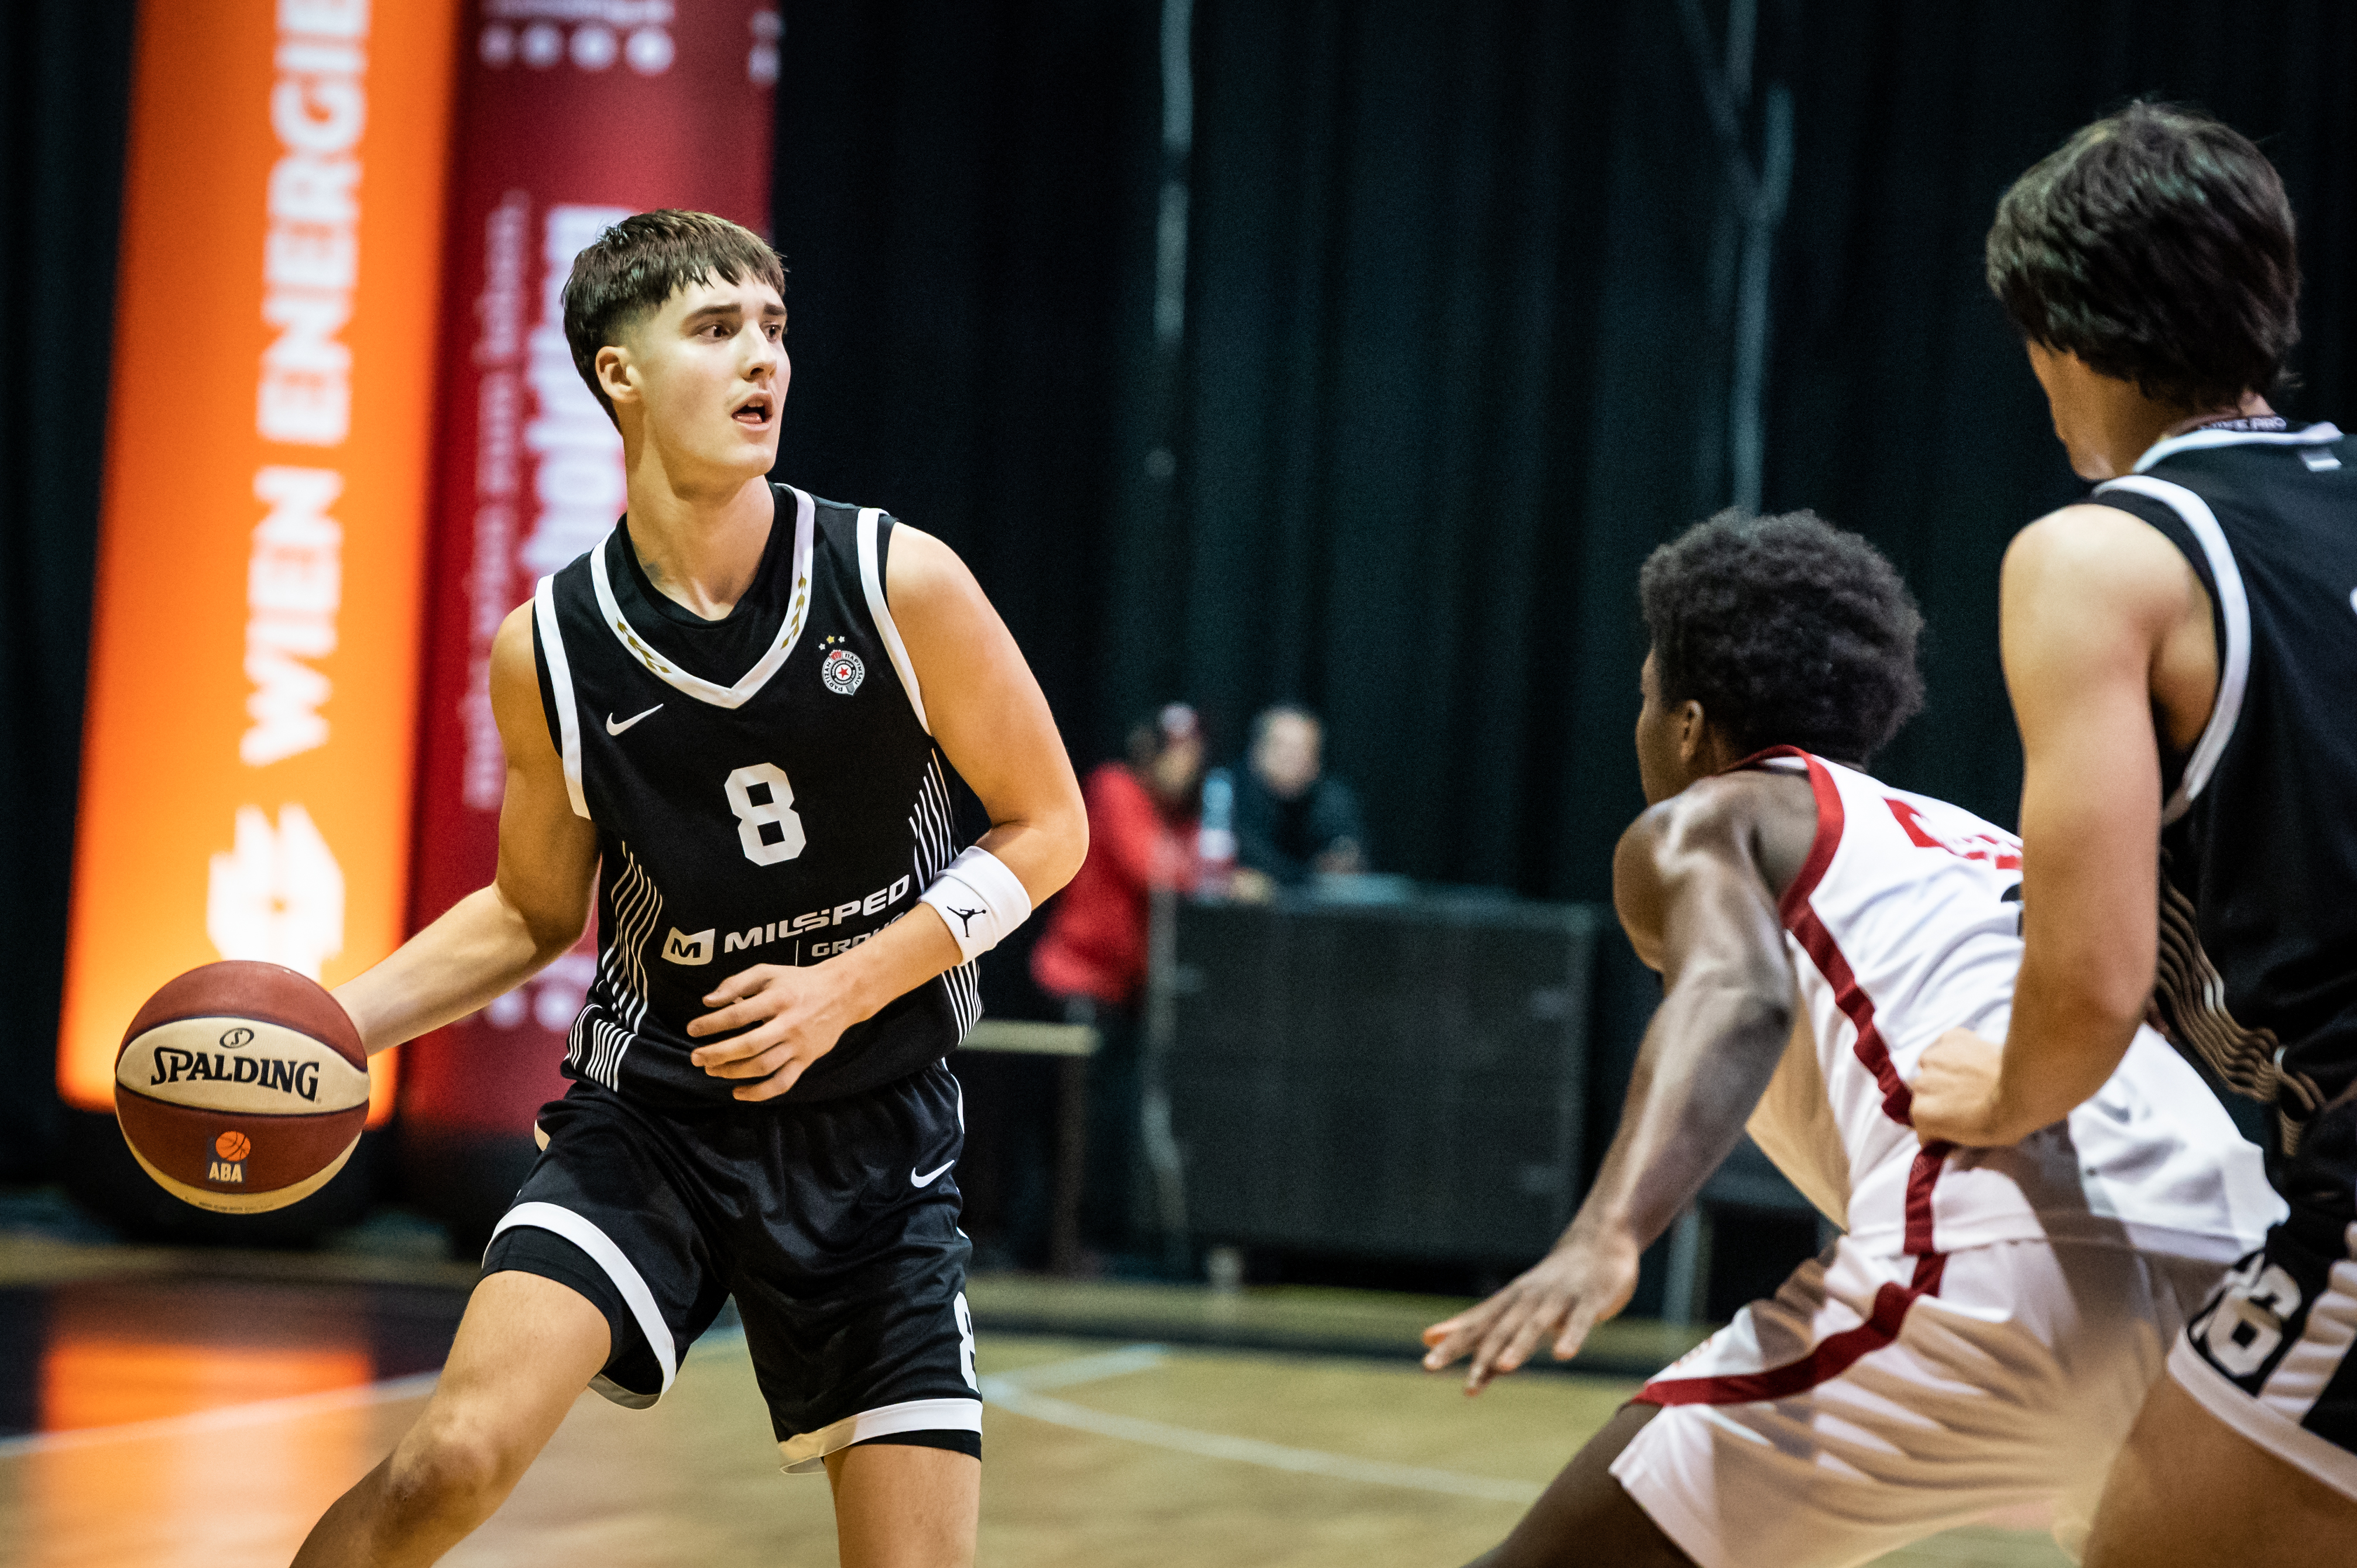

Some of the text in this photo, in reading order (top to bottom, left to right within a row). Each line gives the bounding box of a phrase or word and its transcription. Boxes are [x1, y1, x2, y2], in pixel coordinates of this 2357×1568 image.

[242, 0, 371, 766] WIEN ENERGIE
[824, 661, 843, 692] PARTIZAN
[724, 763, 807, 867] 8
[724, 874, 910, 953] MILSPED
[150, 1046, 320, 1103] SPALDING
[209, 1161, 243, 1183] ABA
